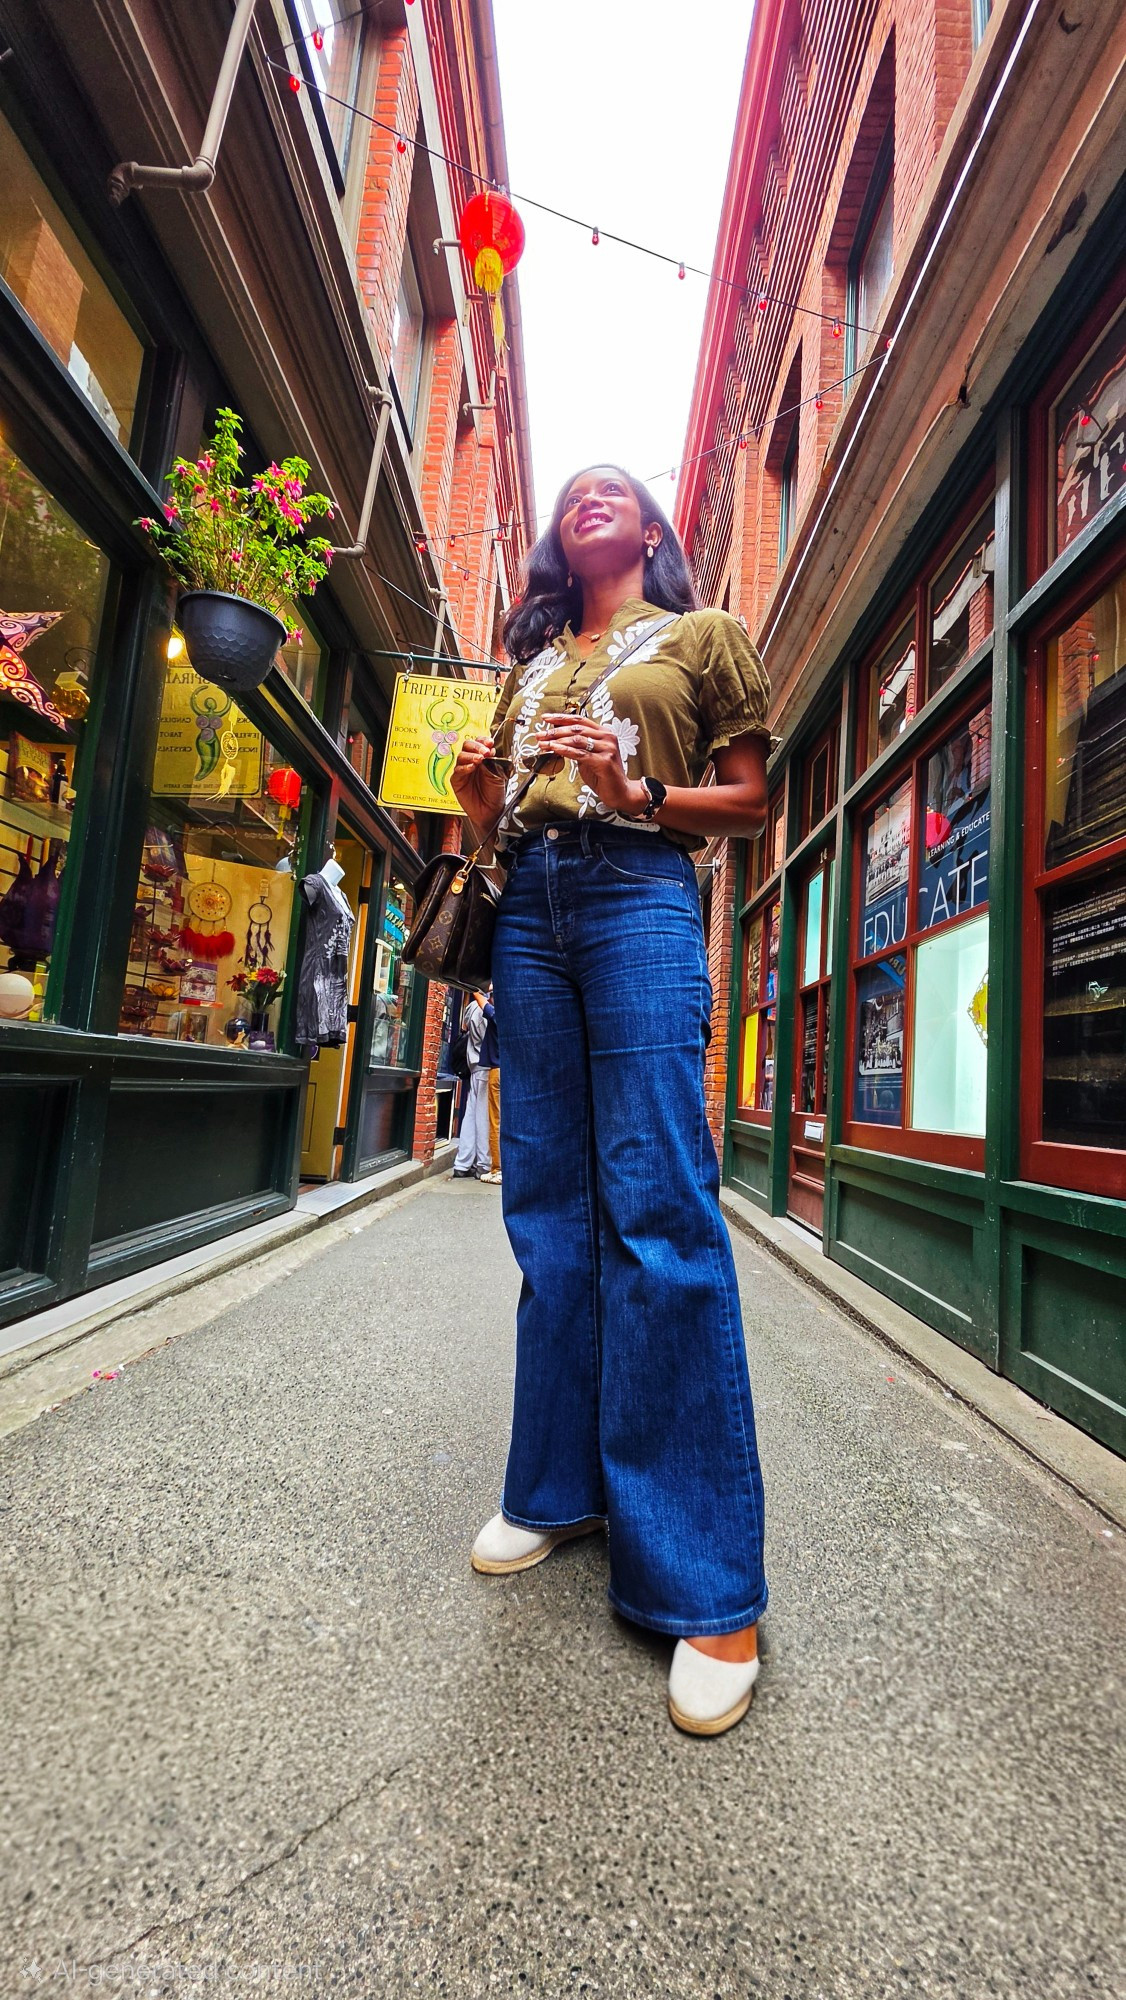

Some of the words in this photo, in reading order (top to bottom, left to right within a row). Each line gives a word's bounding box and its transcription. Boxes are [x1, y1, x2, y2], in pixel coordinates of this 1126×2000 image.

[402, 681, 449, 698] TRIPLE
[394, 726, 418, 734] BOOKS
[391, 741, 421, 749] JEWELRY
[390, 755, 419, 764] INCENSE
[928, 835, 955, 859] LEARNING
